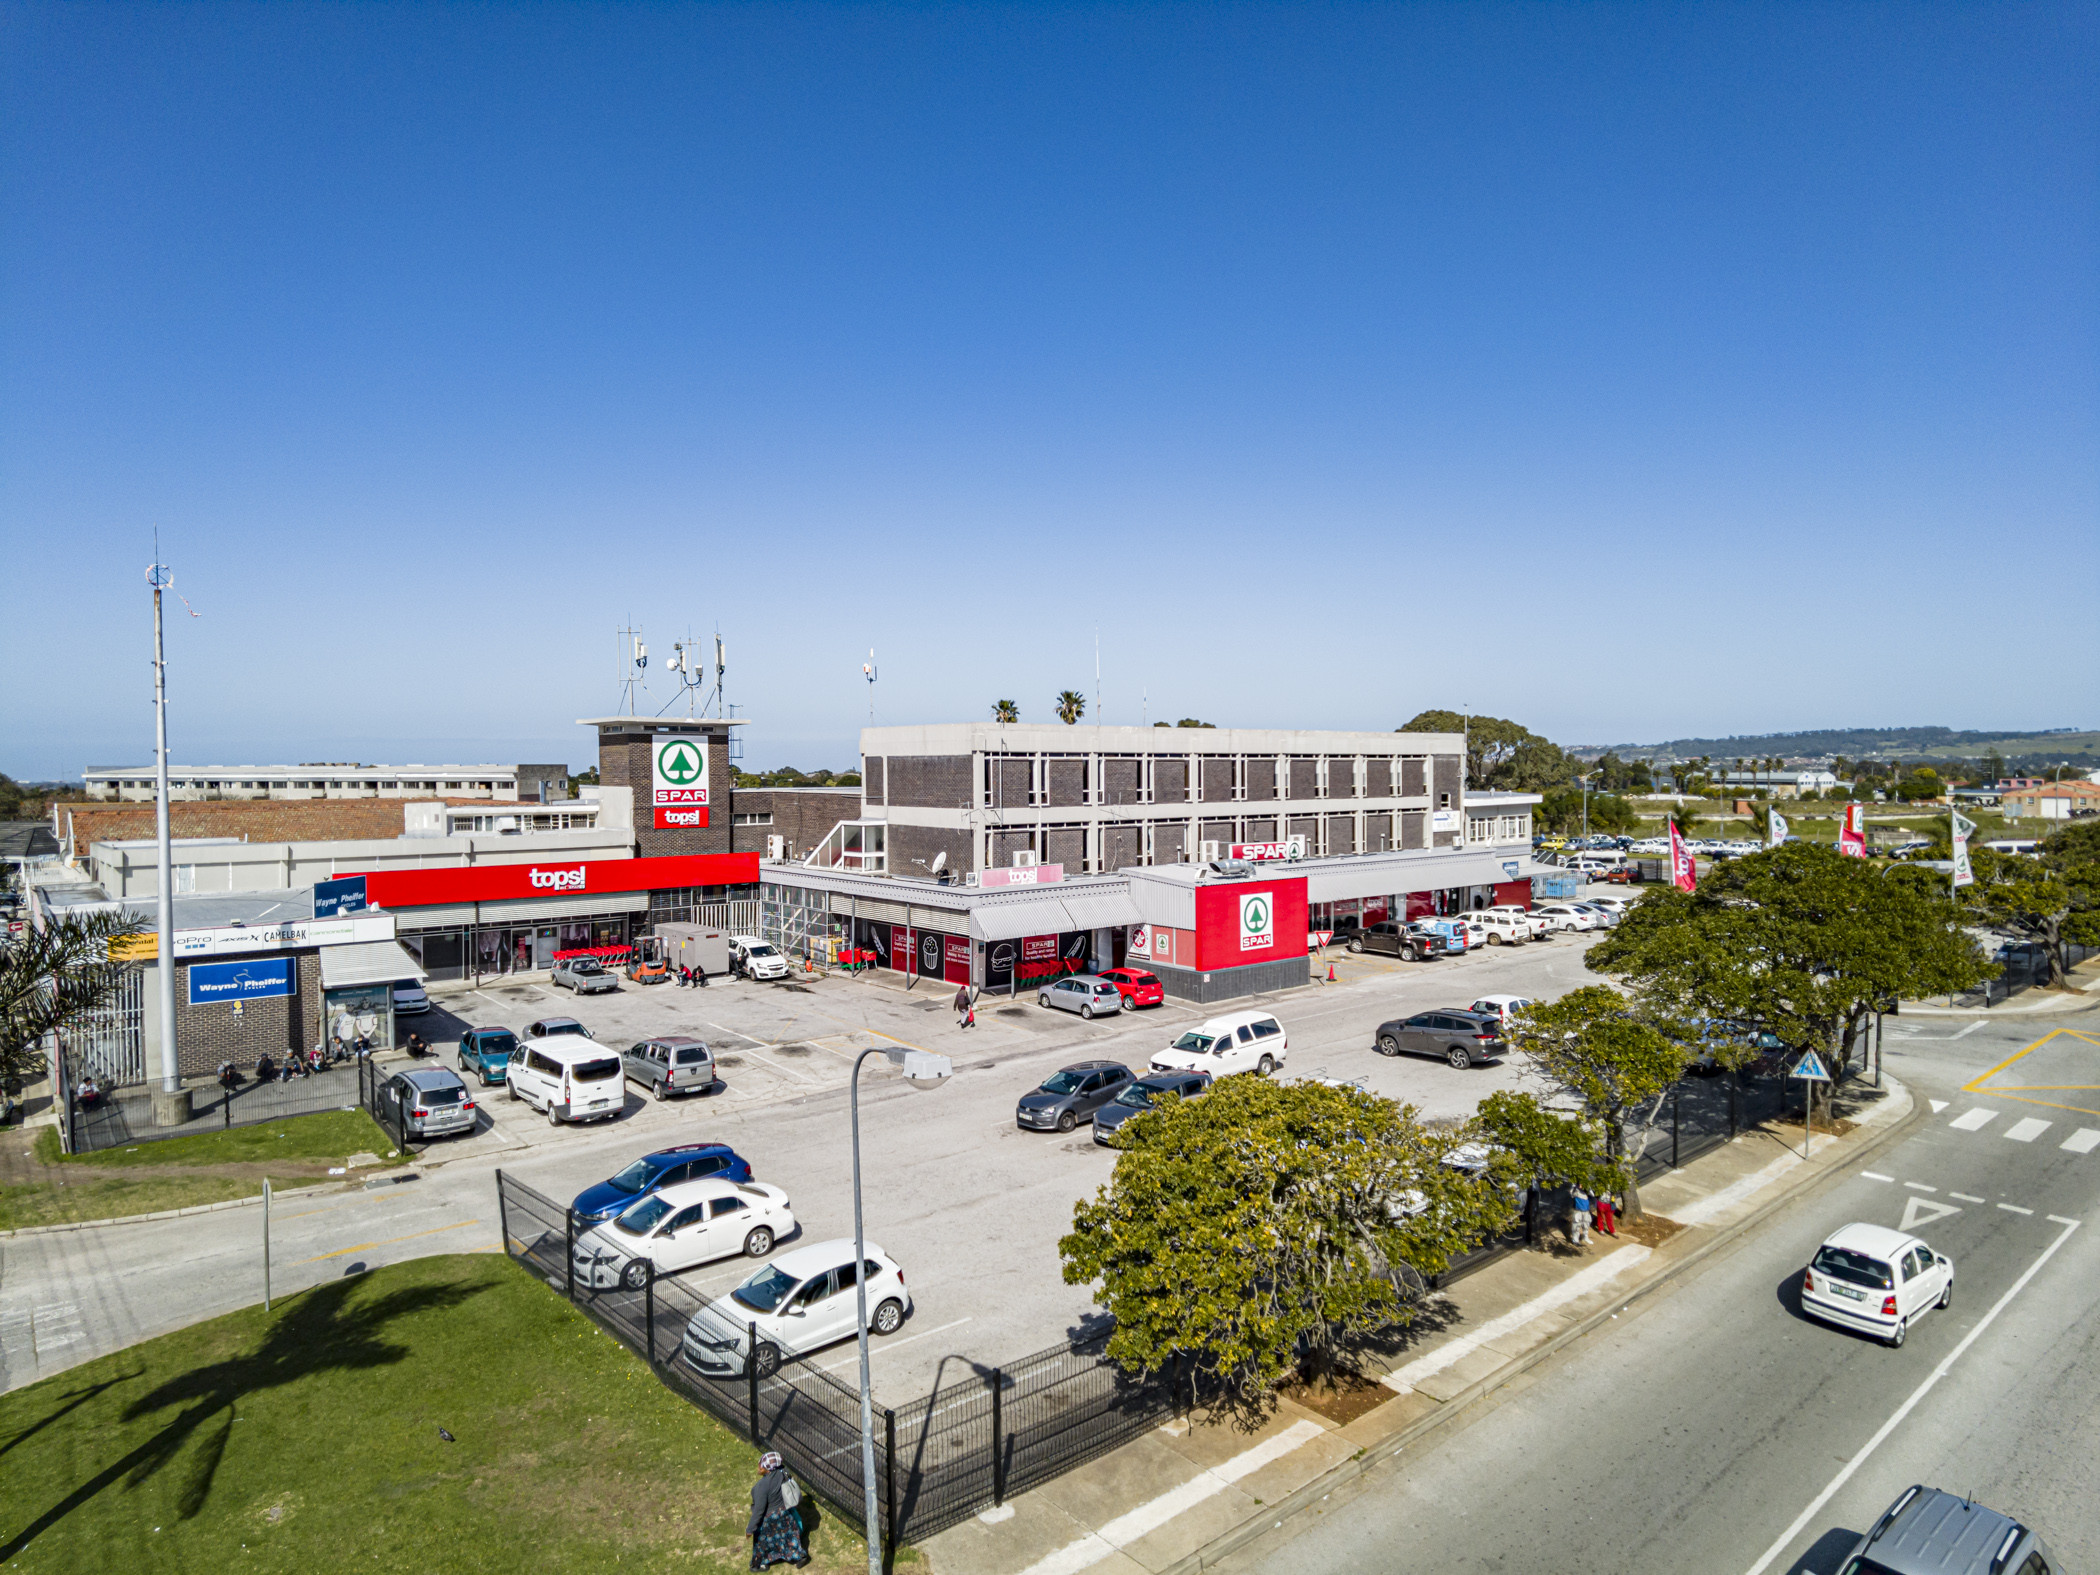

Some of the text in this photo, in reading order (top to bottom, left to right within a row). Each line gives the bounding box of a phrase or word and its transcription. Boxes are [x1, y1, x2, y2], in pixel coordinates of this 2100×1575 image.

[657, 790, 706, 801] SPAR
[664, 810, 700, 825] tops!
[1242, 844, 1287, 860] SPAR
[529, 865, 586, 891] tops!
[1008, 867, 1038, 884] tops!
[315, 892, 365, 908] Wayne Pheiffer
[173, 936, 212, 945] oPro
[264, 929, 307, 942] CAMELBAK
[1243, 936, 1271, 947] SPAR
[199, 978, 288, 992] Wayne Pheiffer
